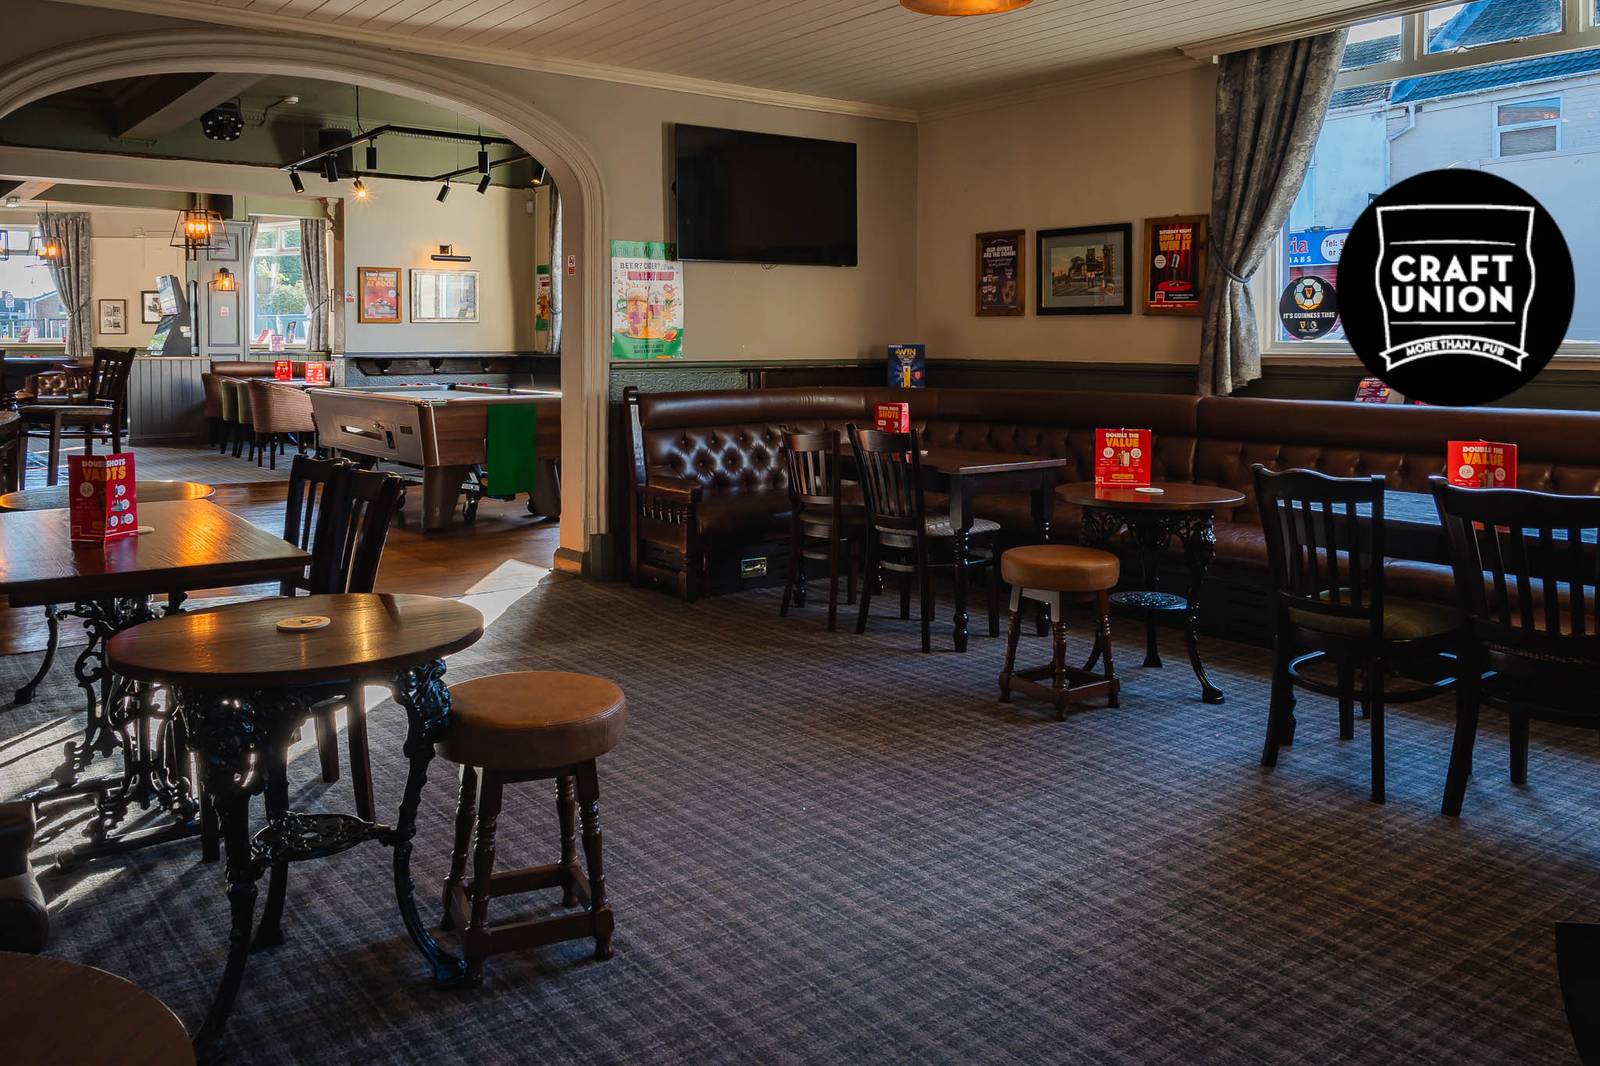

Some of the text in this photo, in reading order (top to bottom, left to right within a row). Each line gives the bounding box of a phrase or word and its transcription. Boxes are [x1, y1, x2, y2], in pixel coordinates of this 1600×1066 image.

[1160, 240, 1191, 250] WIN IT
[1290, 237, 1308, 254] ia
[1106, 438, 1139, 448] VALUE
[106, 458, 126, 467] SHOTS
[1462, 452, 1504, 466] VALUE
